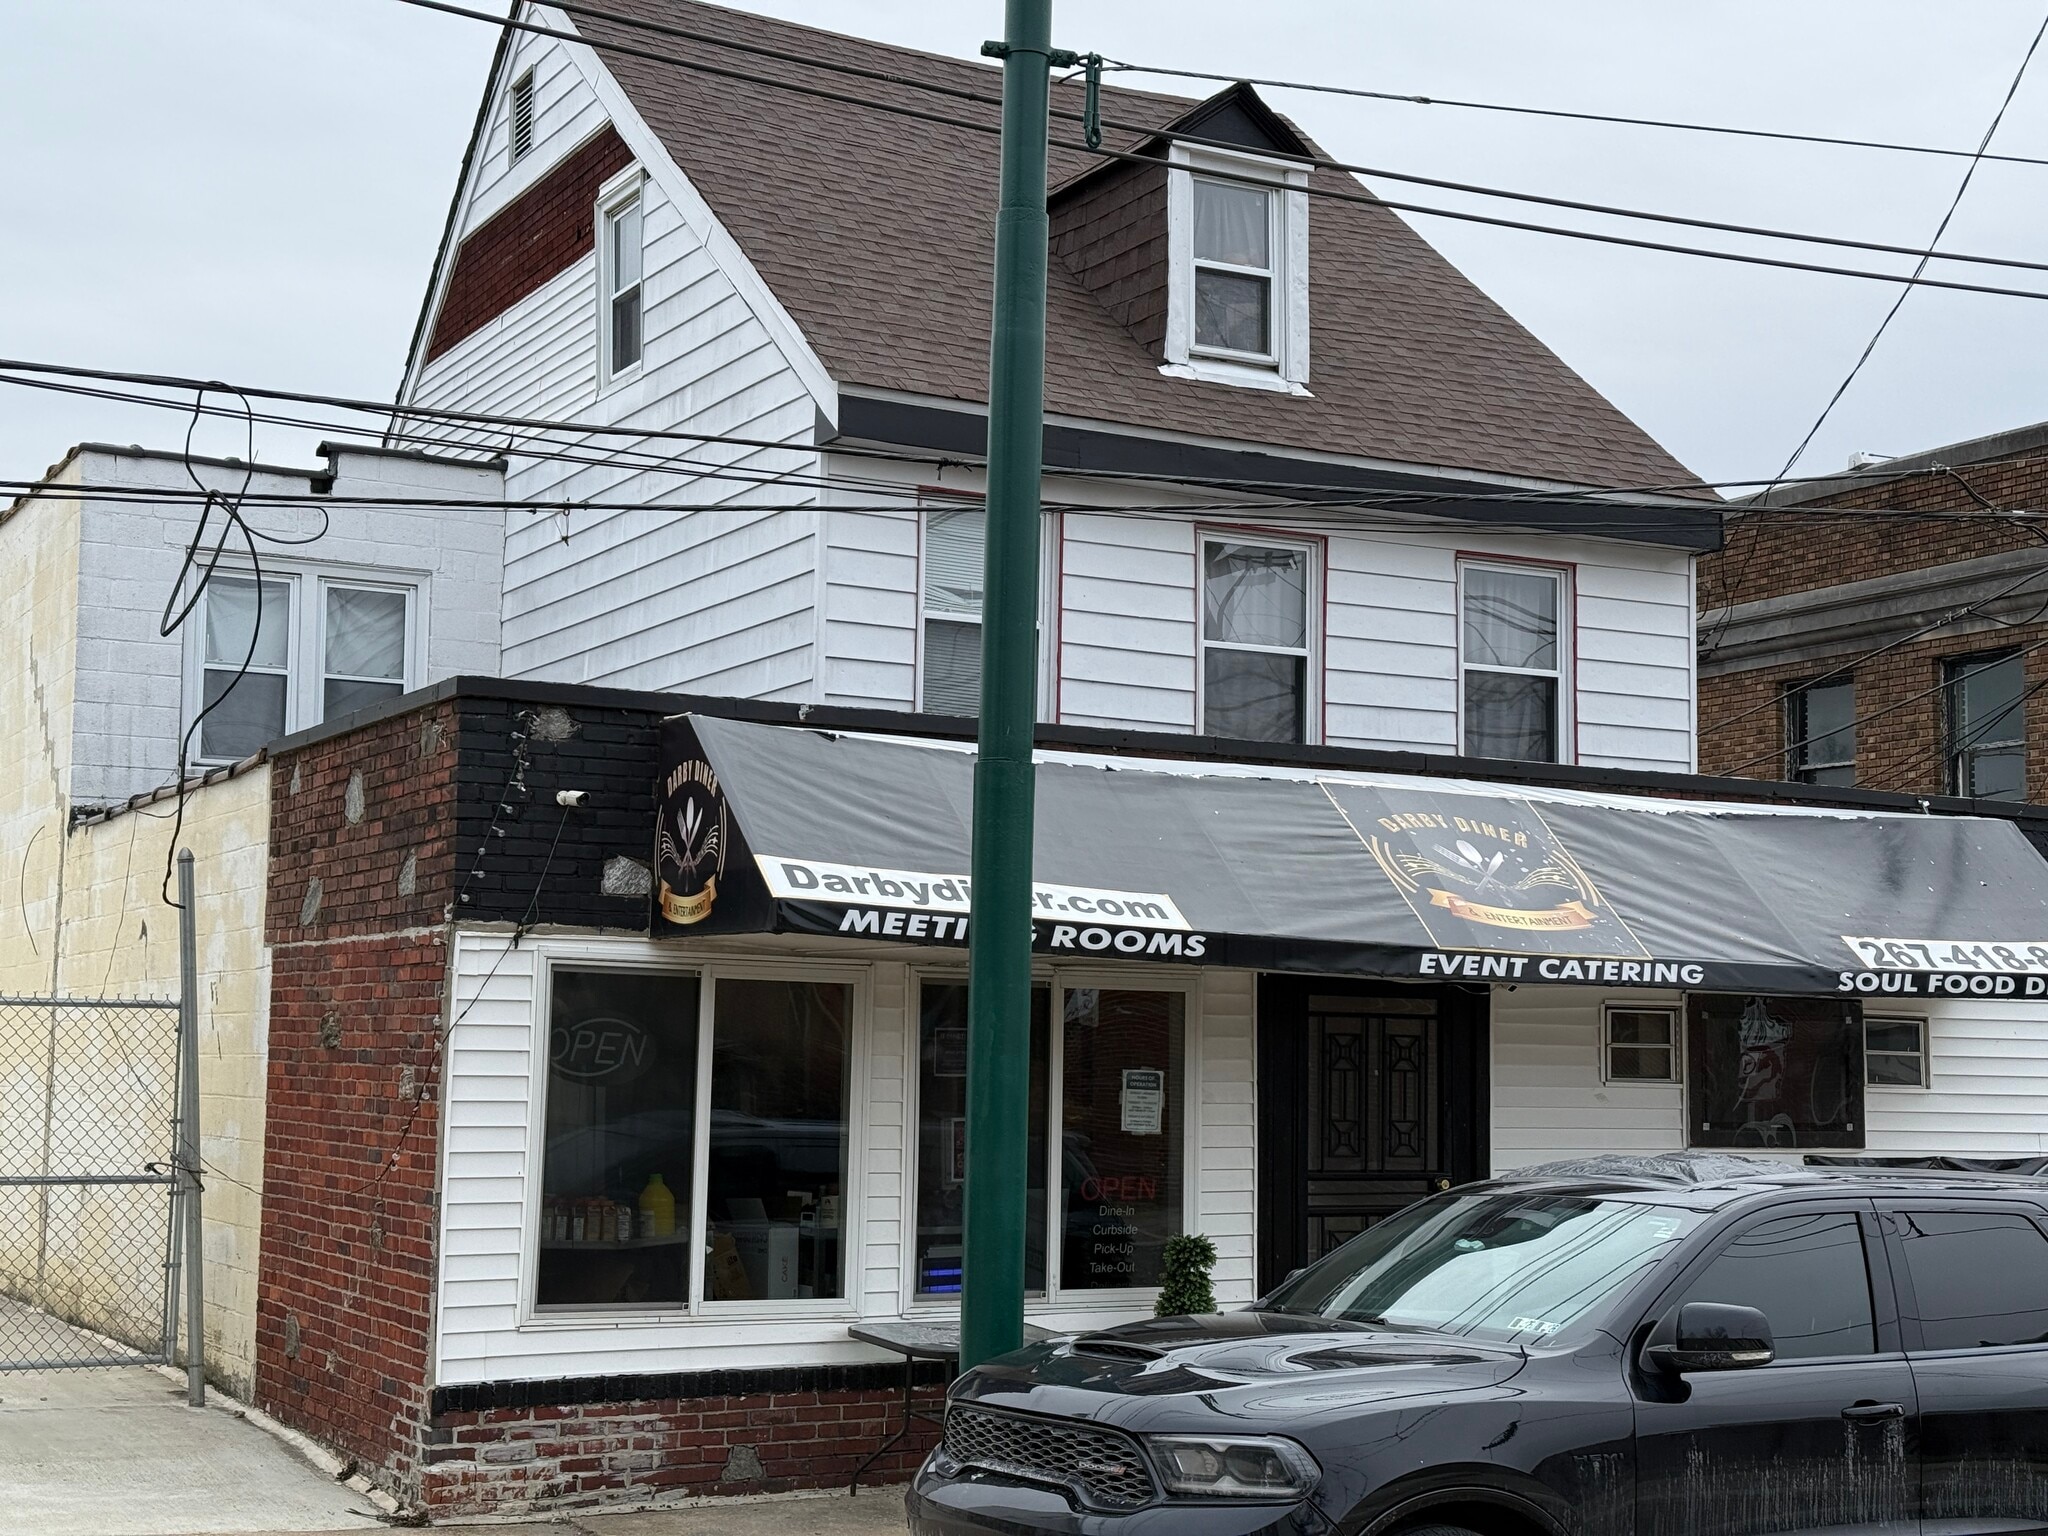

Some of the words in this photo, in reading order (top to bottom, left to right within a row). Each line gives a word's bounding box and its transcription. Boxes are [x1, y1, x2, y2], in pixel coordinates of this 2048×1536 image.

[667, 759, 693, 798] DARBY
[694, 759, 719, 798] DINER
[1377, 813, 1448, 833] DARBY
[1453, 816, 1529, 848] DINER
[780, 862, 1170, 921] Darbydir.com
[673, 899, 706, 917] ENTERTAINMENT
[1469, 907, 1479, 917] &
[1486, 911, 1574, 927] ENTERTAINMENT
[838, 908, 1037, 947] MEETI
[1050, 924, 1208, 958] ROOMS
[1419, 953, 1529, 977] EVENT
[1538, 958, 1705, 985] CATERING
[1838, 971, 1918, 993] SOUL
[1927, 974, 2016, 995] FOOD
[2025, 976, 2048, 995] D
[1081, 1176, 1157, 1201] OPEN
[1099, 1205, 1135, 1217] Dine-In
[1093, 1223, 1138, 1236] Curbside
[1094, 1243, 1134, 1256] Pick-Up
[1090, 1262, 1135, 1274] Take-Out
